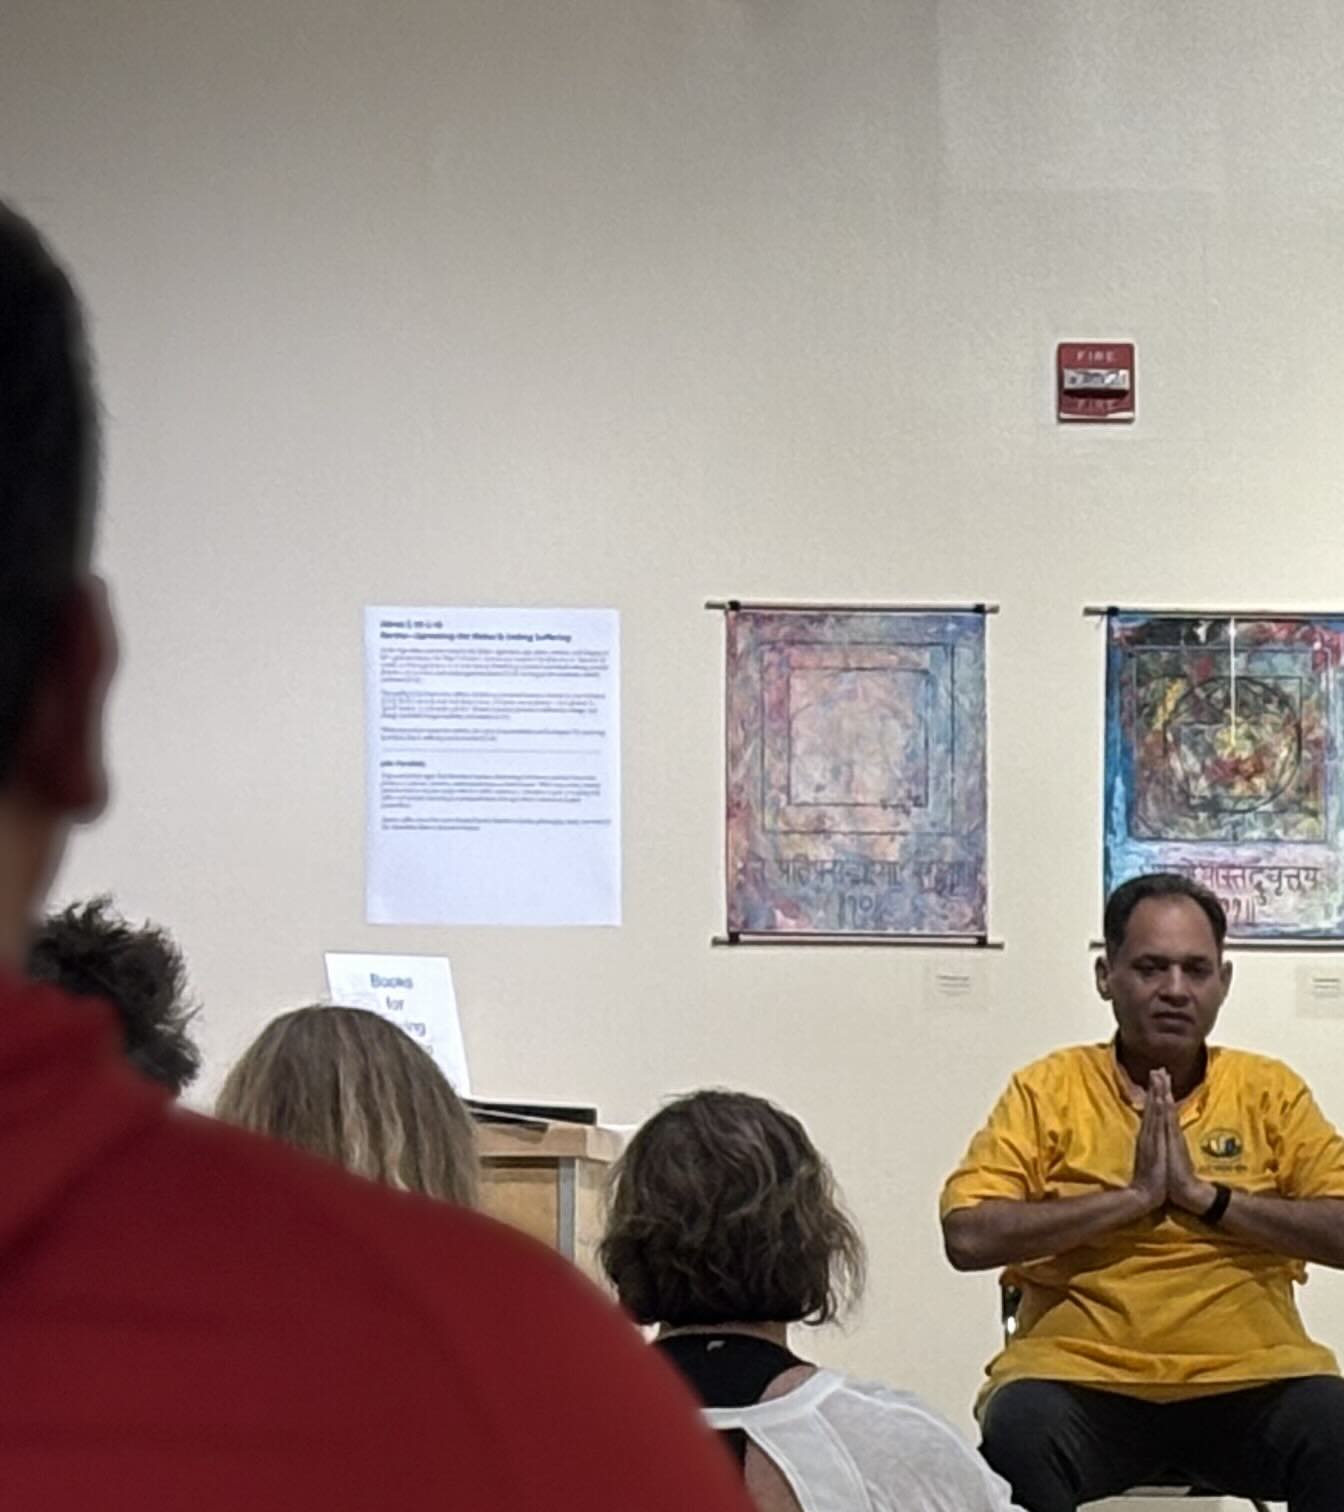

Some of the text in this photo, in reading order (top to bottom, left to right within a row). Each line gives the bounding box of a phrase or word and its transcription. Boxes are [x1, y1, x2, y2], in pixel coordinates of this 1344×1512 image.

[1076, 350, 1115, 362] FIRE
[1076, 398, 1115, 410] FIRE
[370, 973, 414, 990] Books
[385, 996, 404, 1011] for
